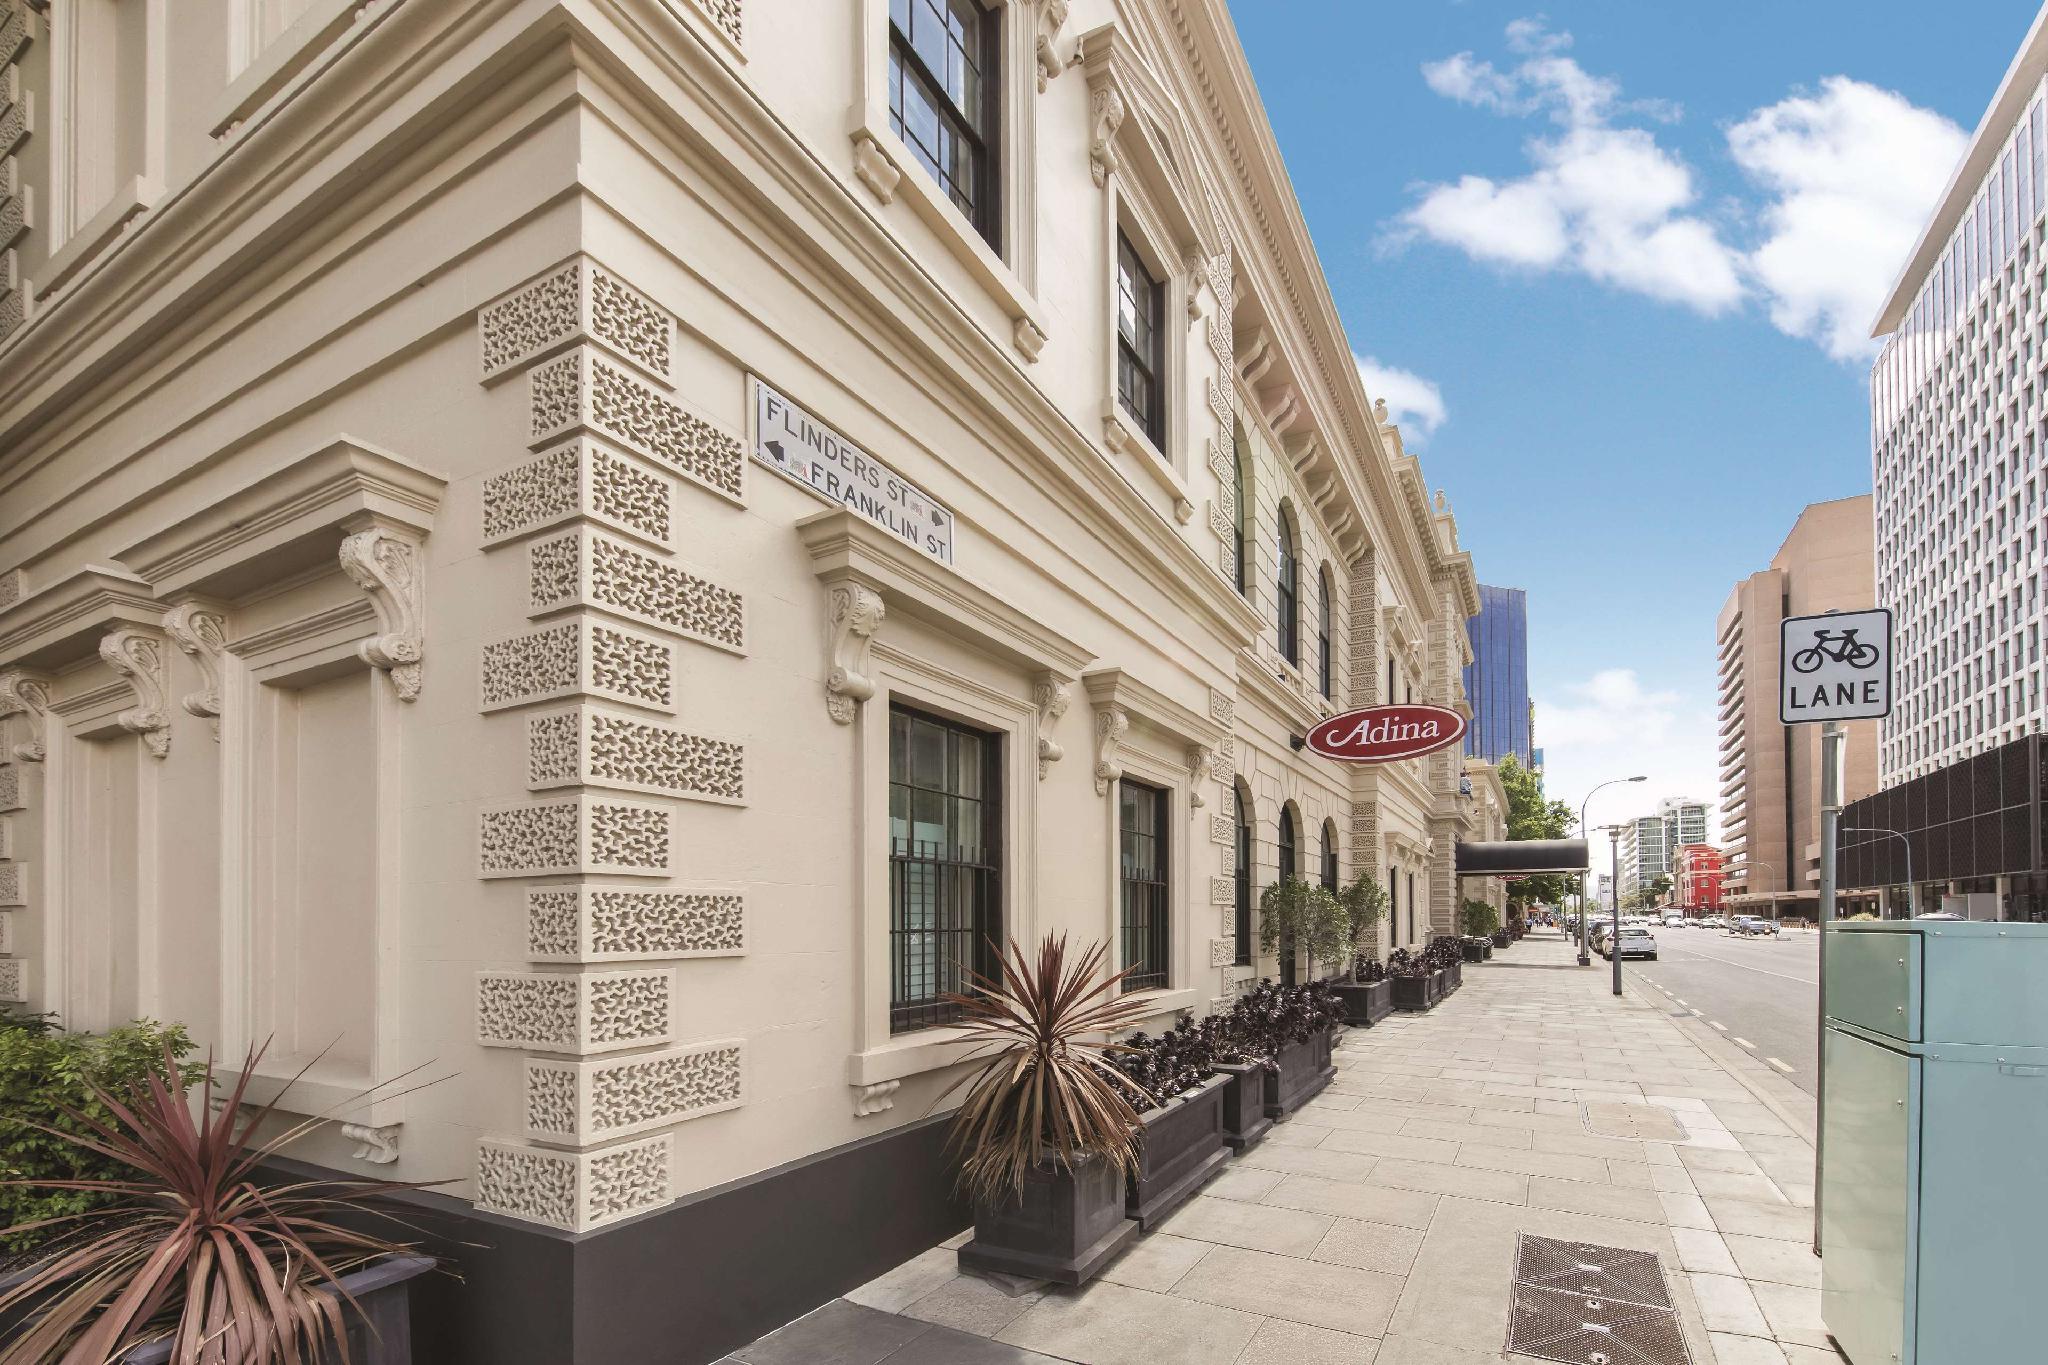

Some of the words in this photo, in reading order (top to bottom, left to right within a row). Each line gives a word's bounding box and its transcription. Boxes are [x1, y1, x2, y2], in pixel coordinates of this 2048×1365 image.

[767, 397, 880, 488] FLINDERS
[887, 479, 908, 507] ST
[811, 462, 918, 544] FRANKLIN
[927, 535, 946, 559] ST
[1791, 680, 1879, 709] LANE
[1326, 716, 1440, 748] Adina
